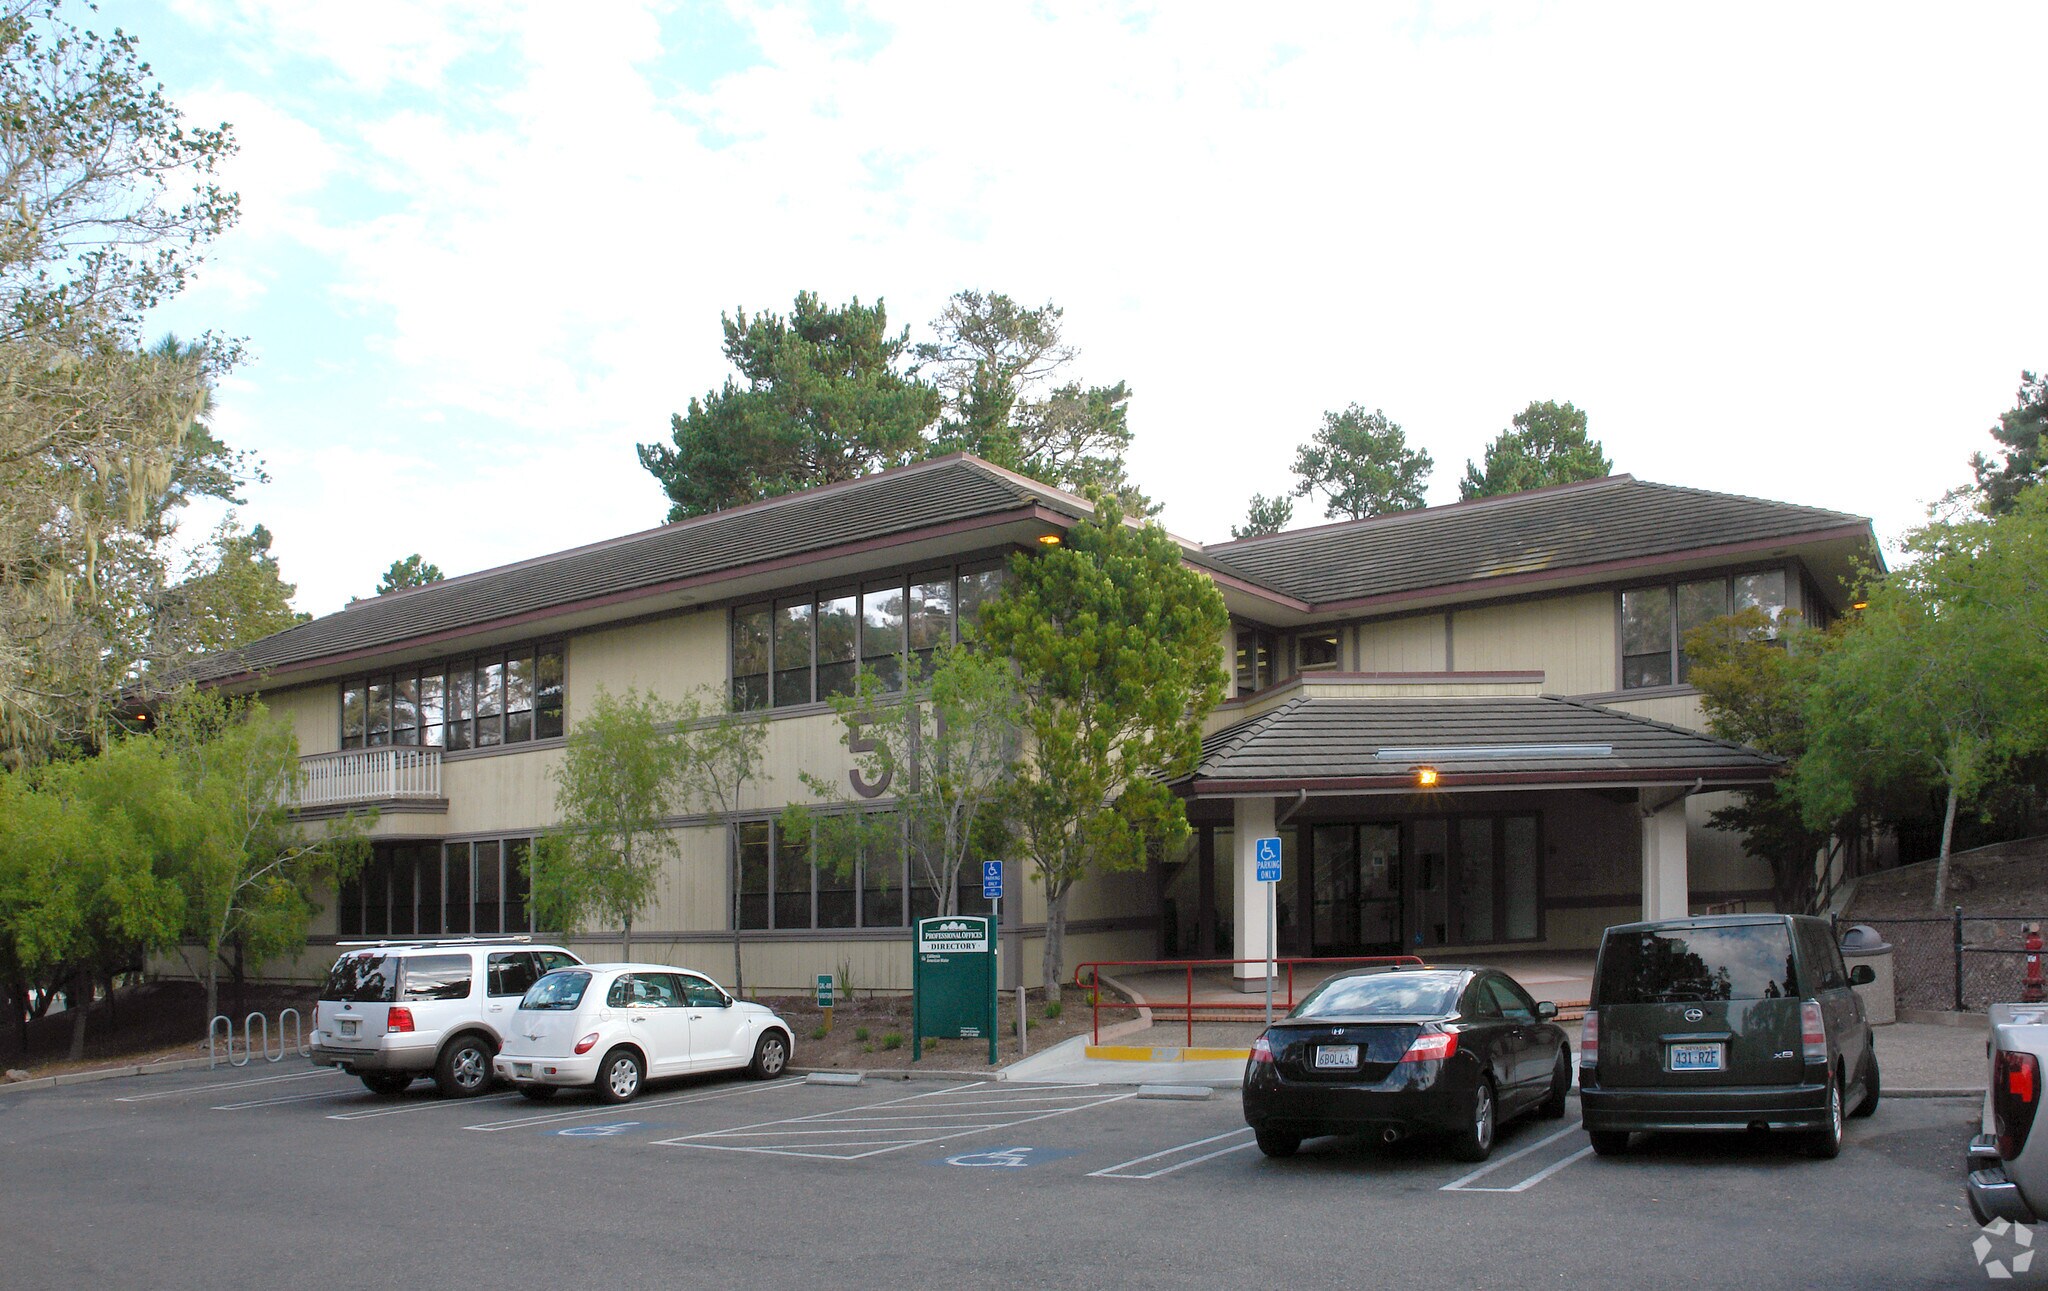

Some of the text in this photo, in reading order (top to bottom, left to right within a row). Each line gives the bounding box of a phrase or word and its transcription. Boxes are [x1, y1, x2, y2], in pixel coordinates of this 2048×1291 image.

[1257, 860, 1280, 869] PARKING
[1261, 870, 1276, 879] ONLY
[931, 942, 977, 950] DIRECTORY
[1675, 1051, 1716, 1064] 431-RZF
